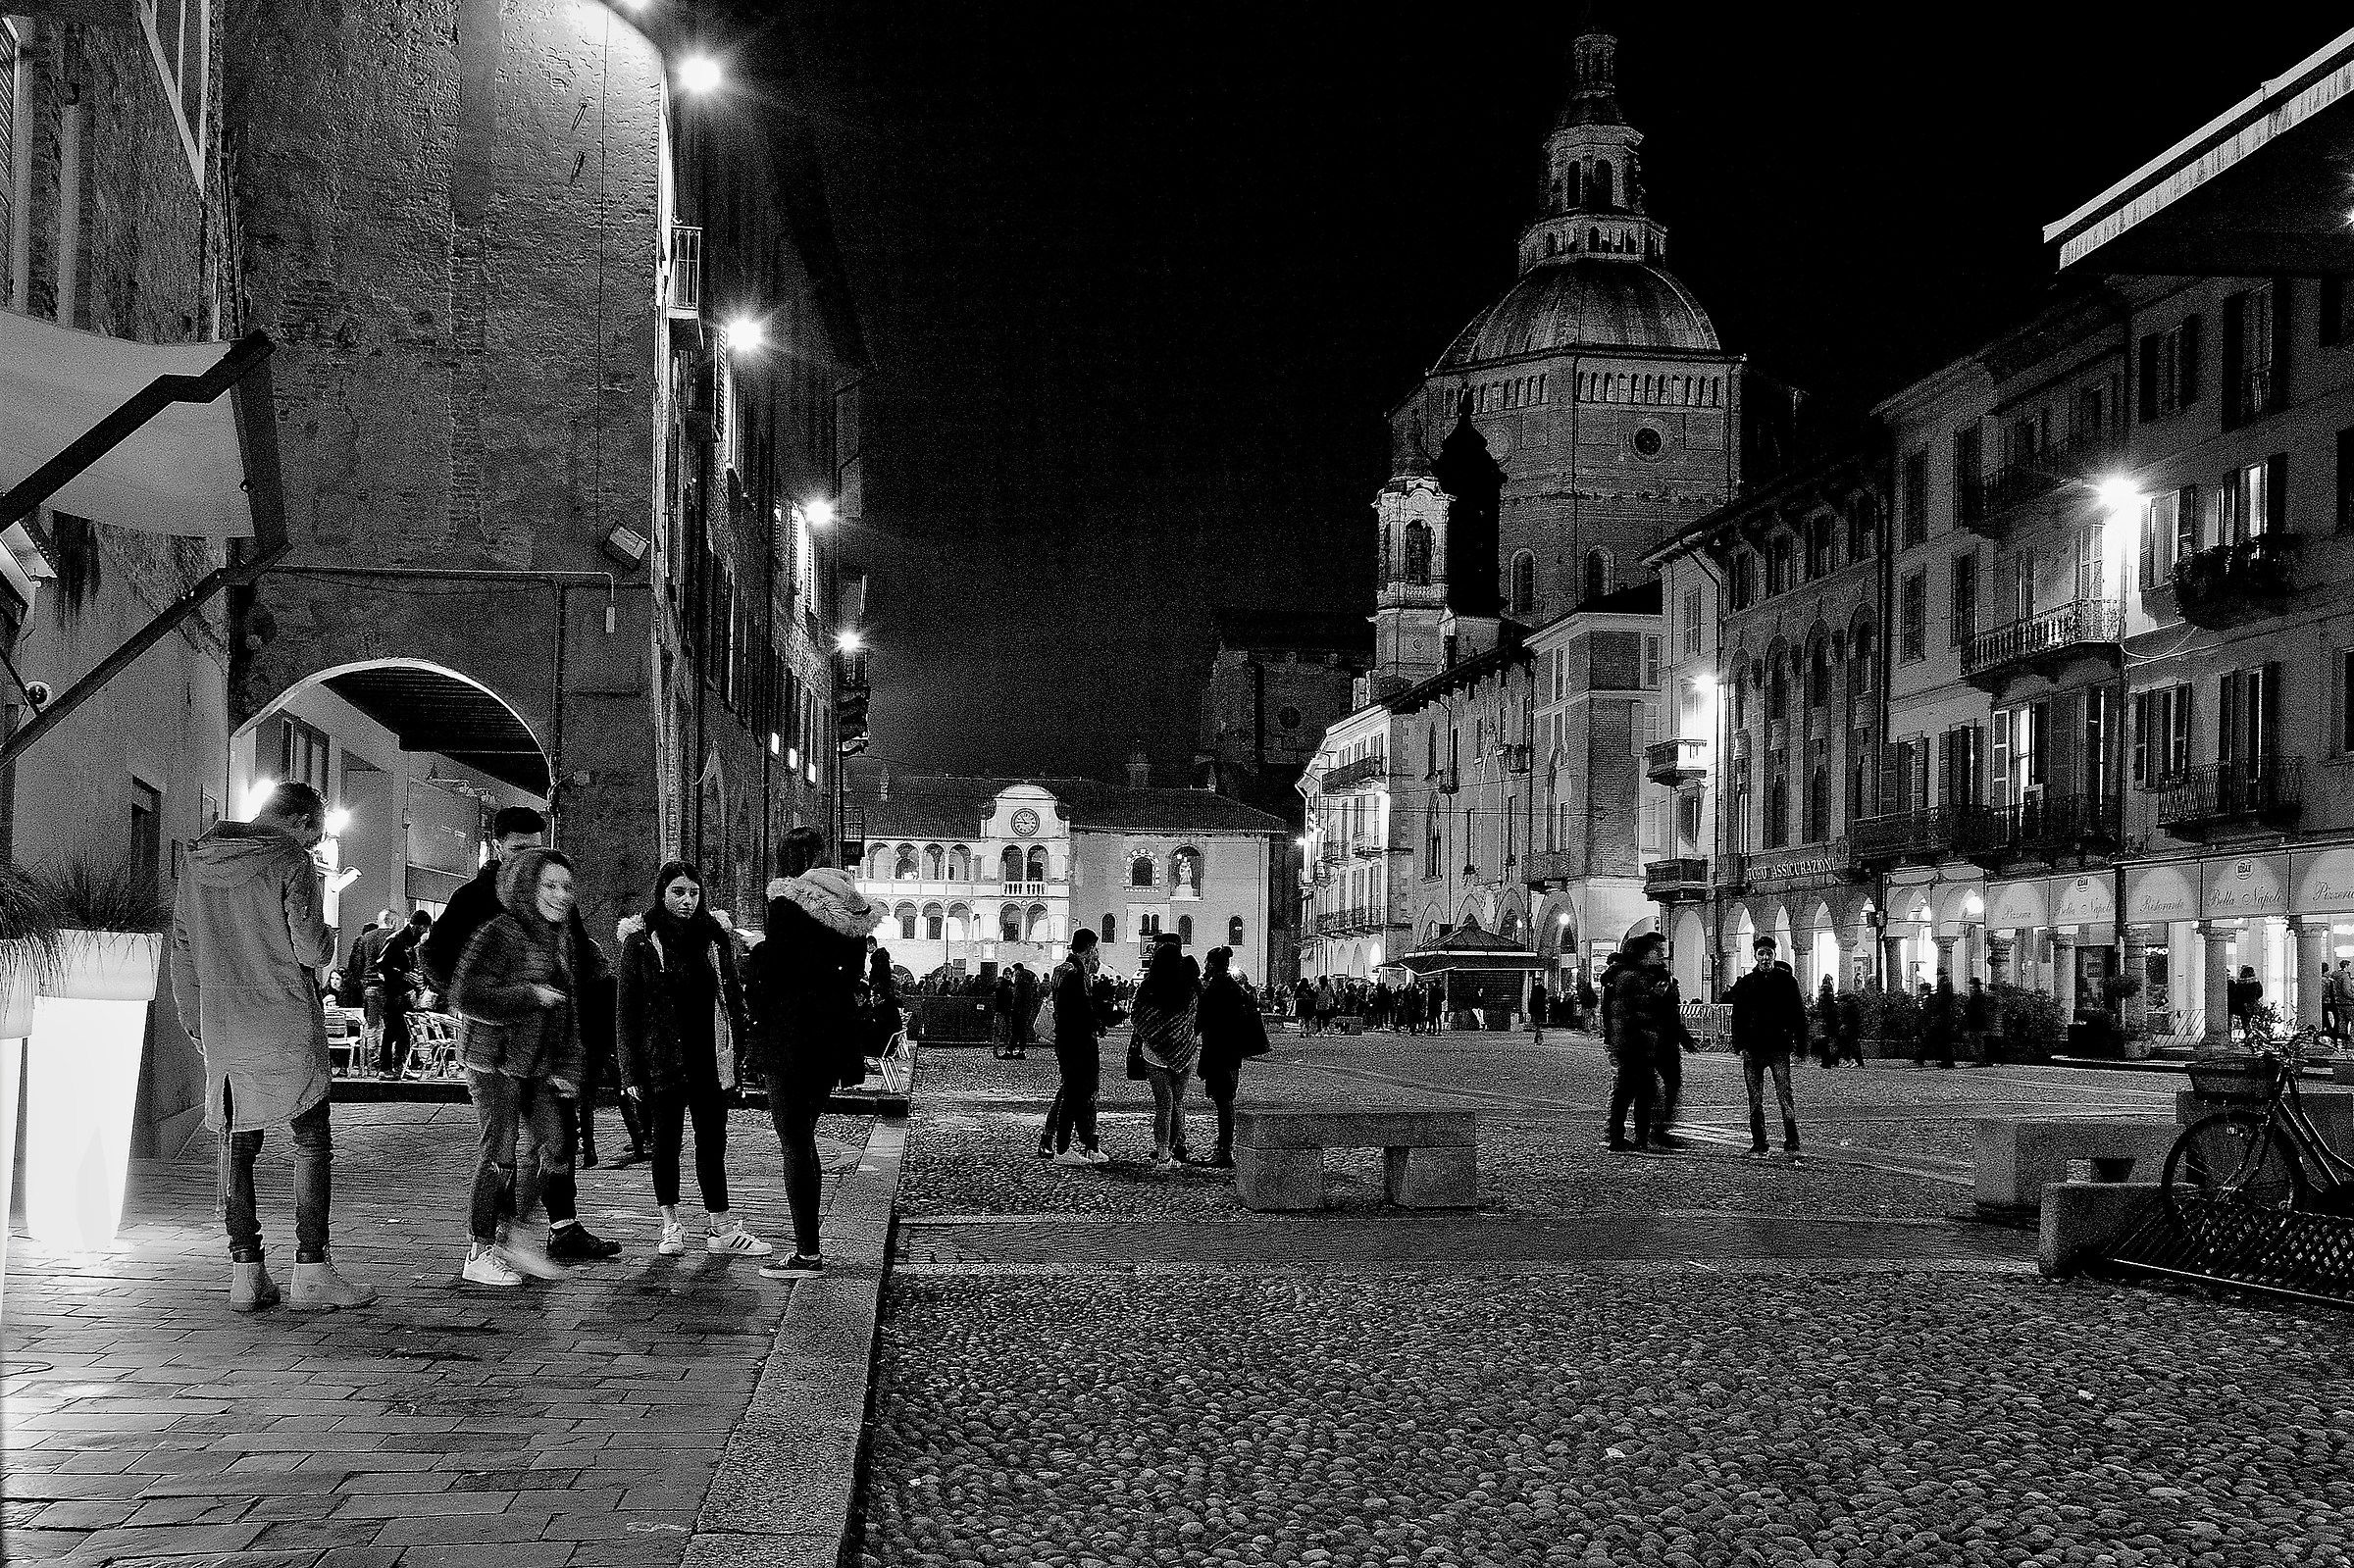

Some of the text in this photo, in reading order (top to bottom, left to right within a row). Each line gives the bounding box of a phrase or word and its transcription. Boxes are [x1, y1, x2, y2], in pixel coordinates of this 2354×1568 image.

[1771, 857, 1836, 880] ASSICURAZIONI
[2209, 885, 2281, 910] Bella Napoli
[2313, 882, 2354, 900] Pizzeri
